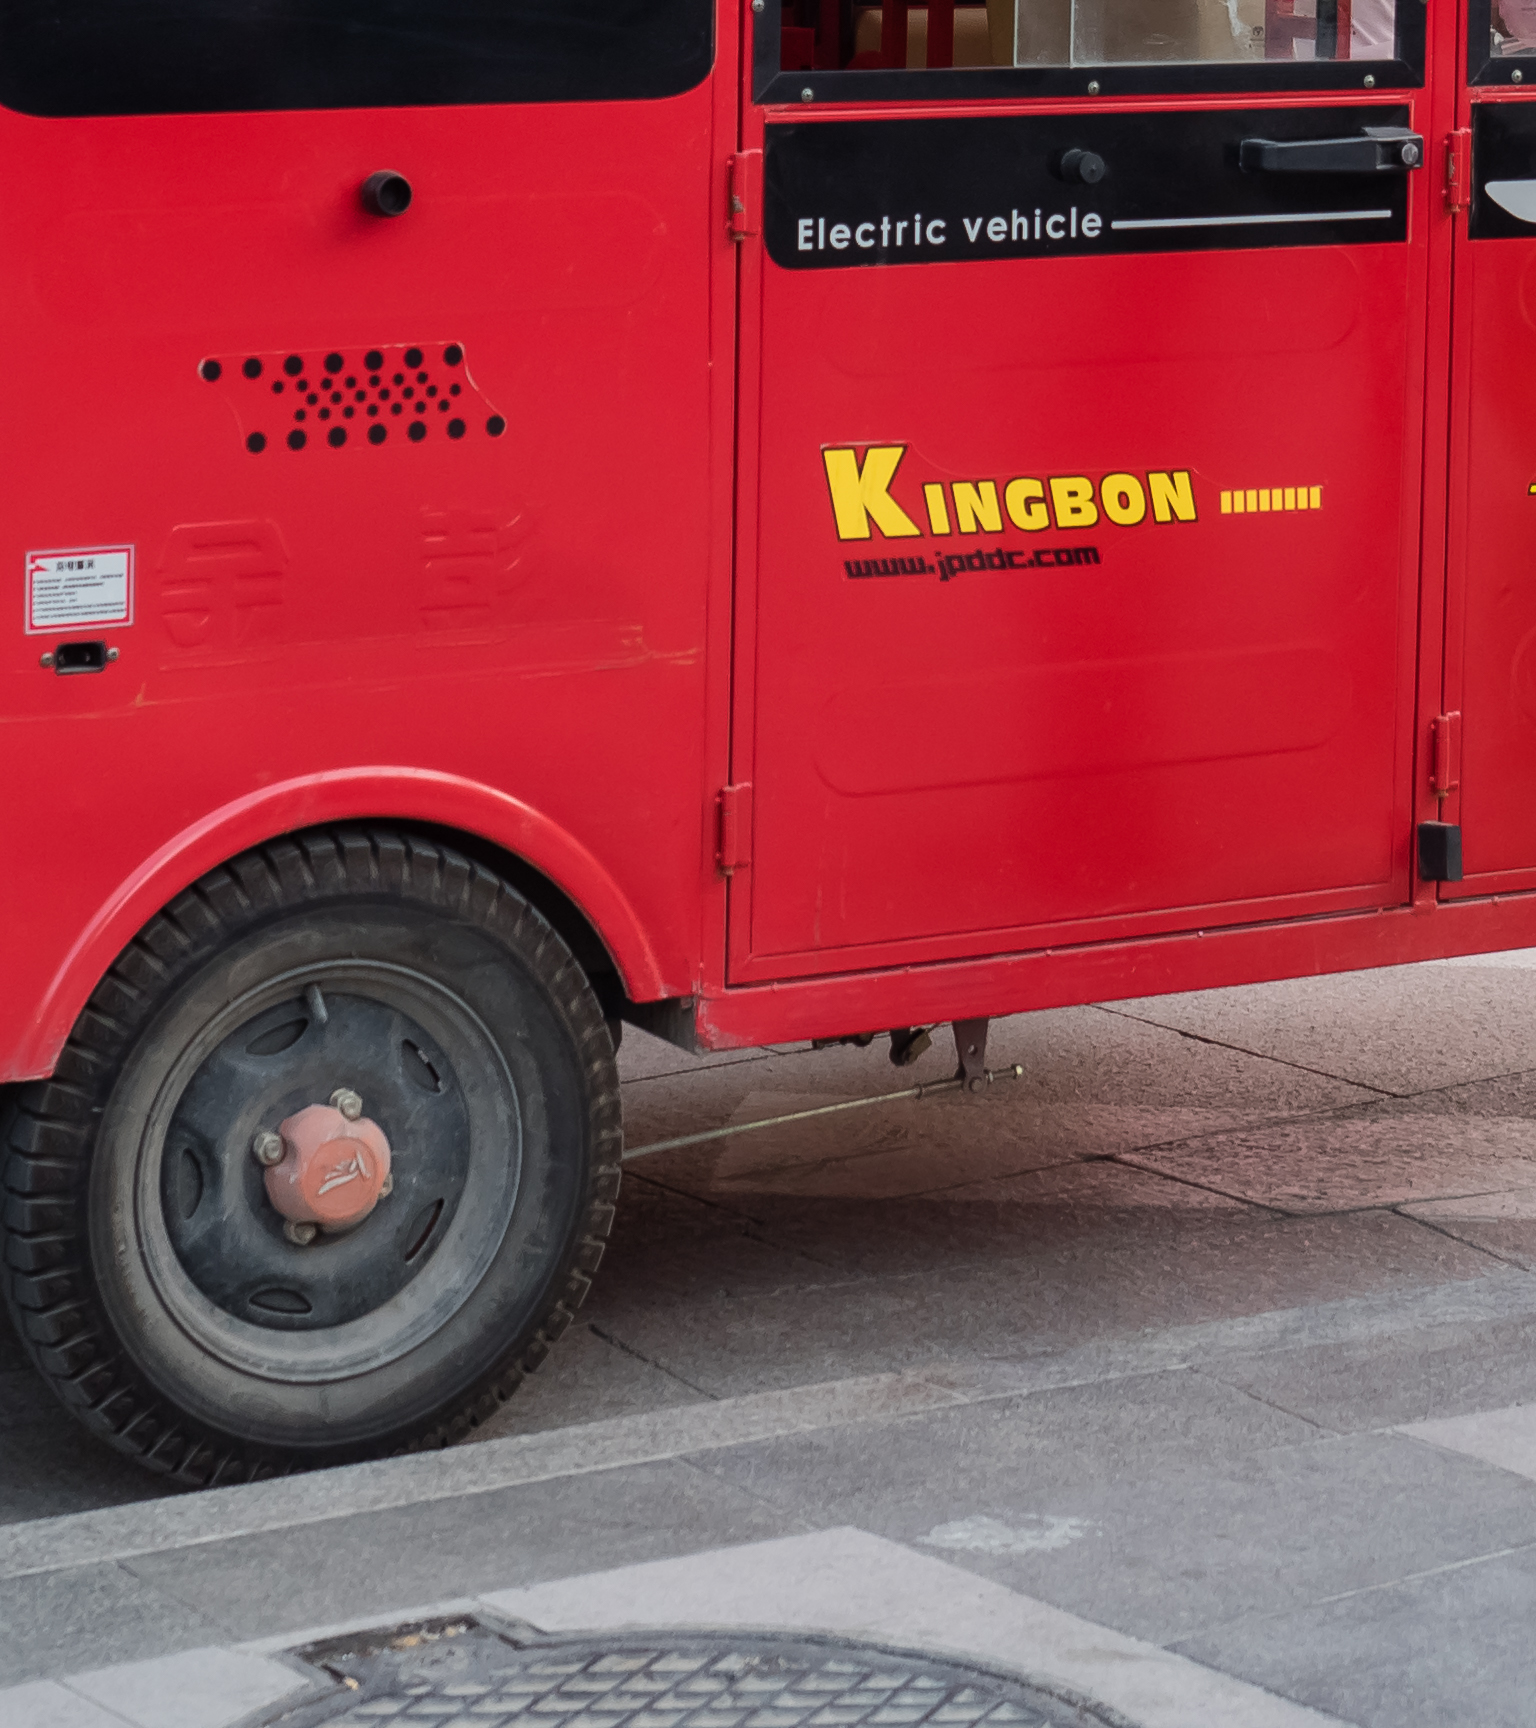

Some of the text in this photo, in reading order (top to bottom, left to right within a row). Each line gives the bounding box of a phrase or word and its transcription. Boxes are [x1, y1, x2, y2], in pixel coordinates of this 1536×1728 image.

[797, 207, 1103, 251] Electric vehicle
[844, 544, 1101, 581] www.jpddc.com
